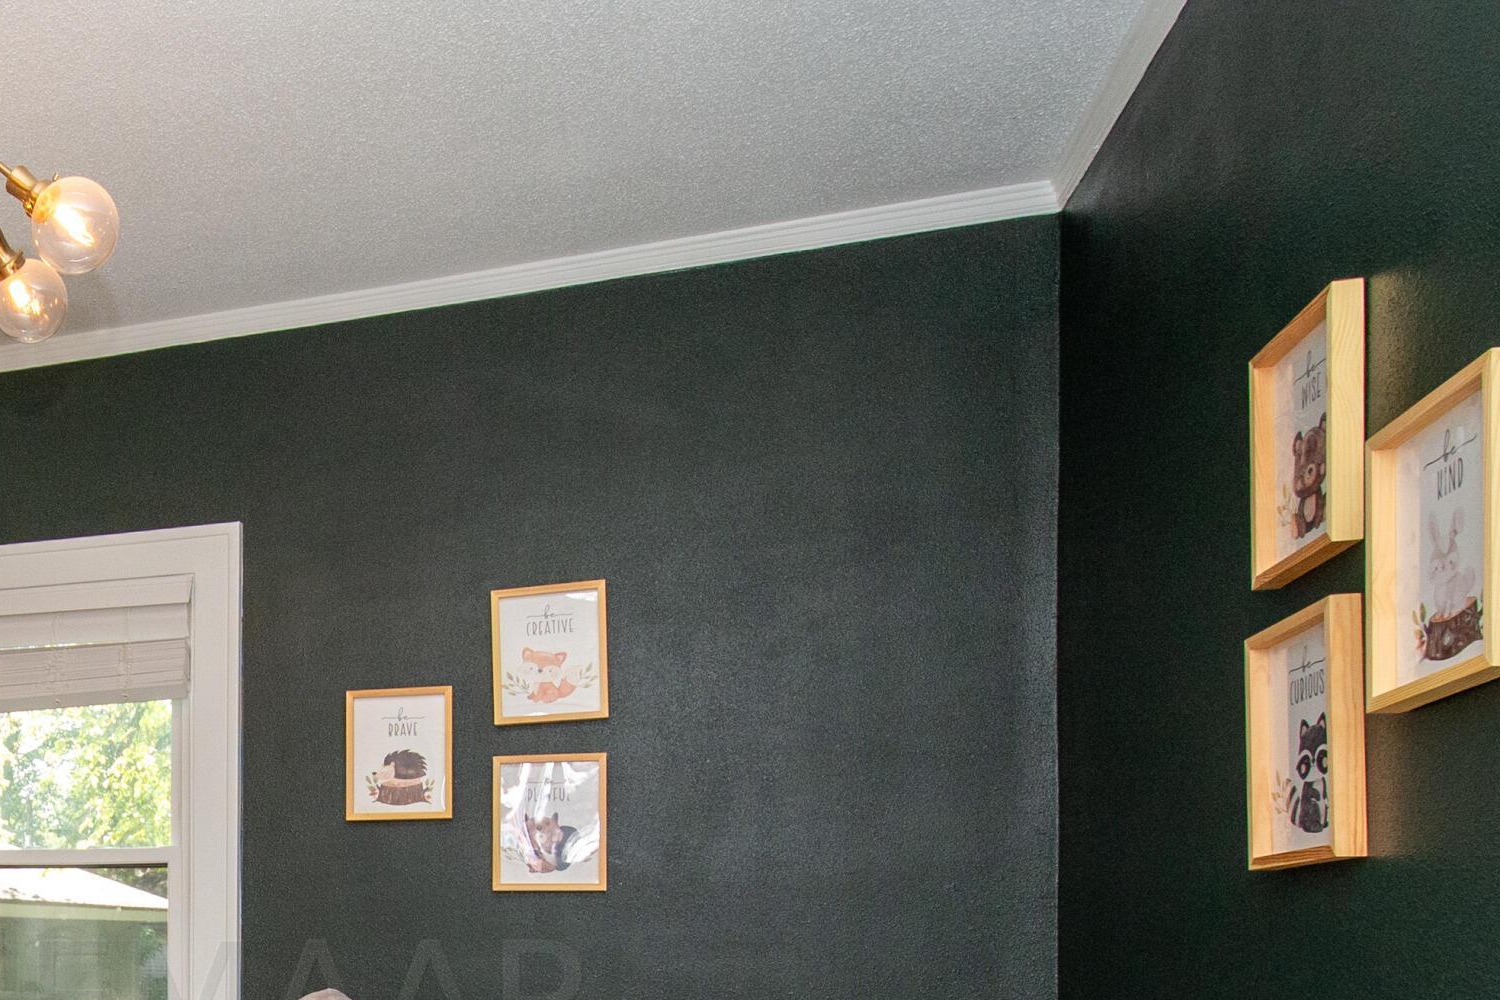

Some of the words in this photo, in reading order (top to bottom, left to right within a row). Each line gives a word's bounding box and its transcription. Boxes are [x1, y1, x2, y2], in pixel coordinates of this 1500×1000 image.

[1300, 371, 1322, 410] WISE
[1436, 457, 1464, 500] KIND
[526, 618, 575, 636] CREATIVE
[1290, 668, 1325, 706] CURIOUS
[388, 722, 418, 737] BRAVE
